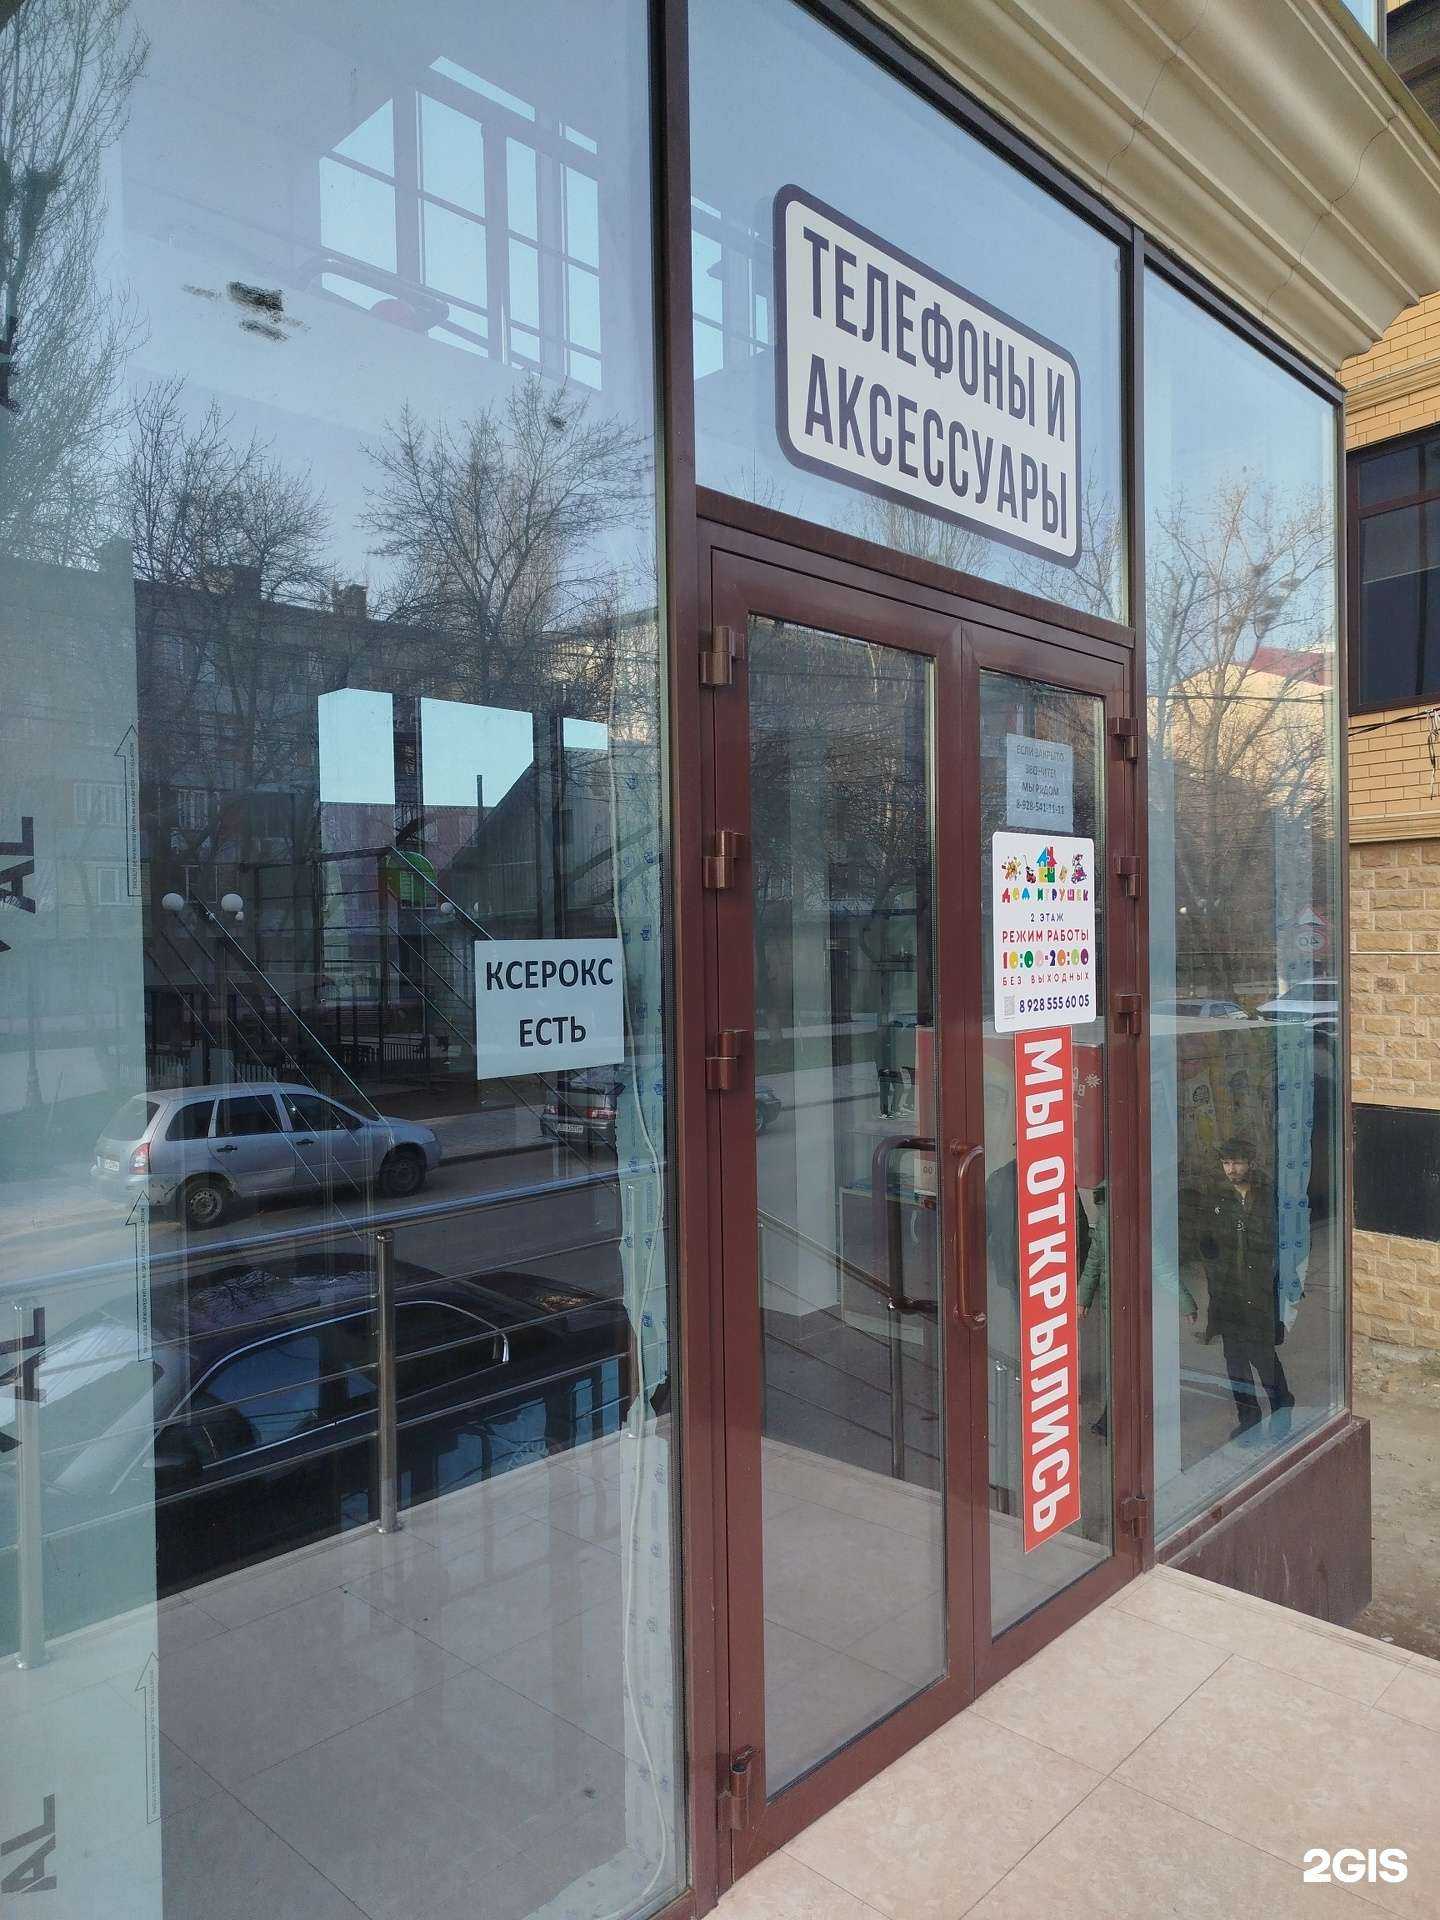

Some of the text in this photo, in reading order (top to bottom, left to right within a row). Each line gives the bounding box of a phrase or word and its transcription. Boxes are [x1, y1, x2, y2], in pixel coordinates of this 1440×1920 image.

[803, 226, 1065, 442] ТЕЛЕФОНЫ И
[804, 353, 1067, 539] АКСЕССУАРЫ
[1030, 912, 1064, 922] 2 ЭТАЖ
[1002, 929, 1089, 943] РЕЖИМ РАБОТЫ
[486, 958, 613, 990] КСЕРОКС
[1002, 948, 1089, 969] 10:00-20:00
[1002, 971, 1089, 986] БЕЗ ВЫХОДНЫХ
[519, 1016, 587, 1047] ЕСТЬ
[1024, 1038, 1070, 1532] МЫ ОТКРЫЛИСЬ
